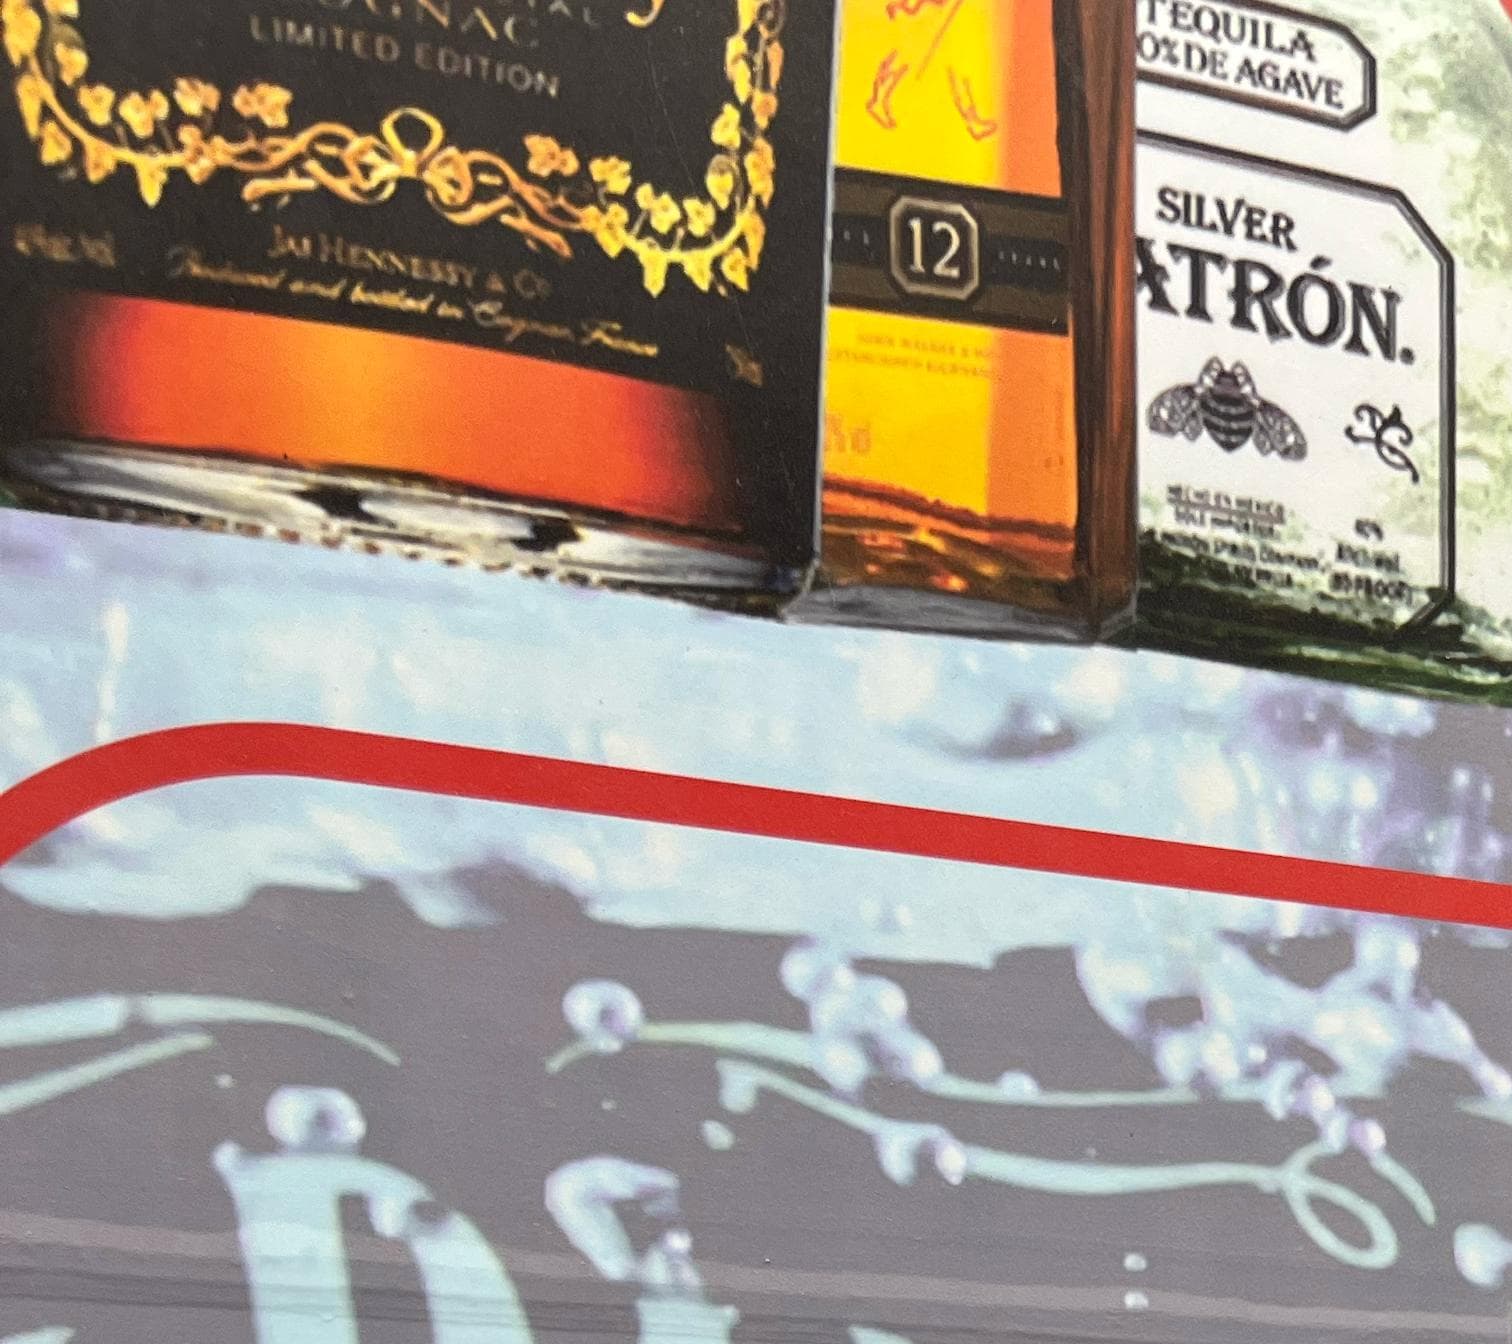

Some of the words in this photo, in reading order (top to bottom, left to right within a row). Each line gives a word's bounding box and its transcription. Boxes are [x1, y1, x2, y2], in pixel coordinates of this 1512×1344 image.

[249, 14, 400, 63] LIMITED
[414, 41, 560, 98] EDITION
[1141, 0, 1317, 63] TEQUILA
[1183, 42, 1229, 80] DE
[1234, 57, 1343, 109] AGAVE
[908, 216, 961, 278] 12
[1156, 186, 1298, 253] SILVER
[1136, 235, 1415, 366] ATRÓN.
